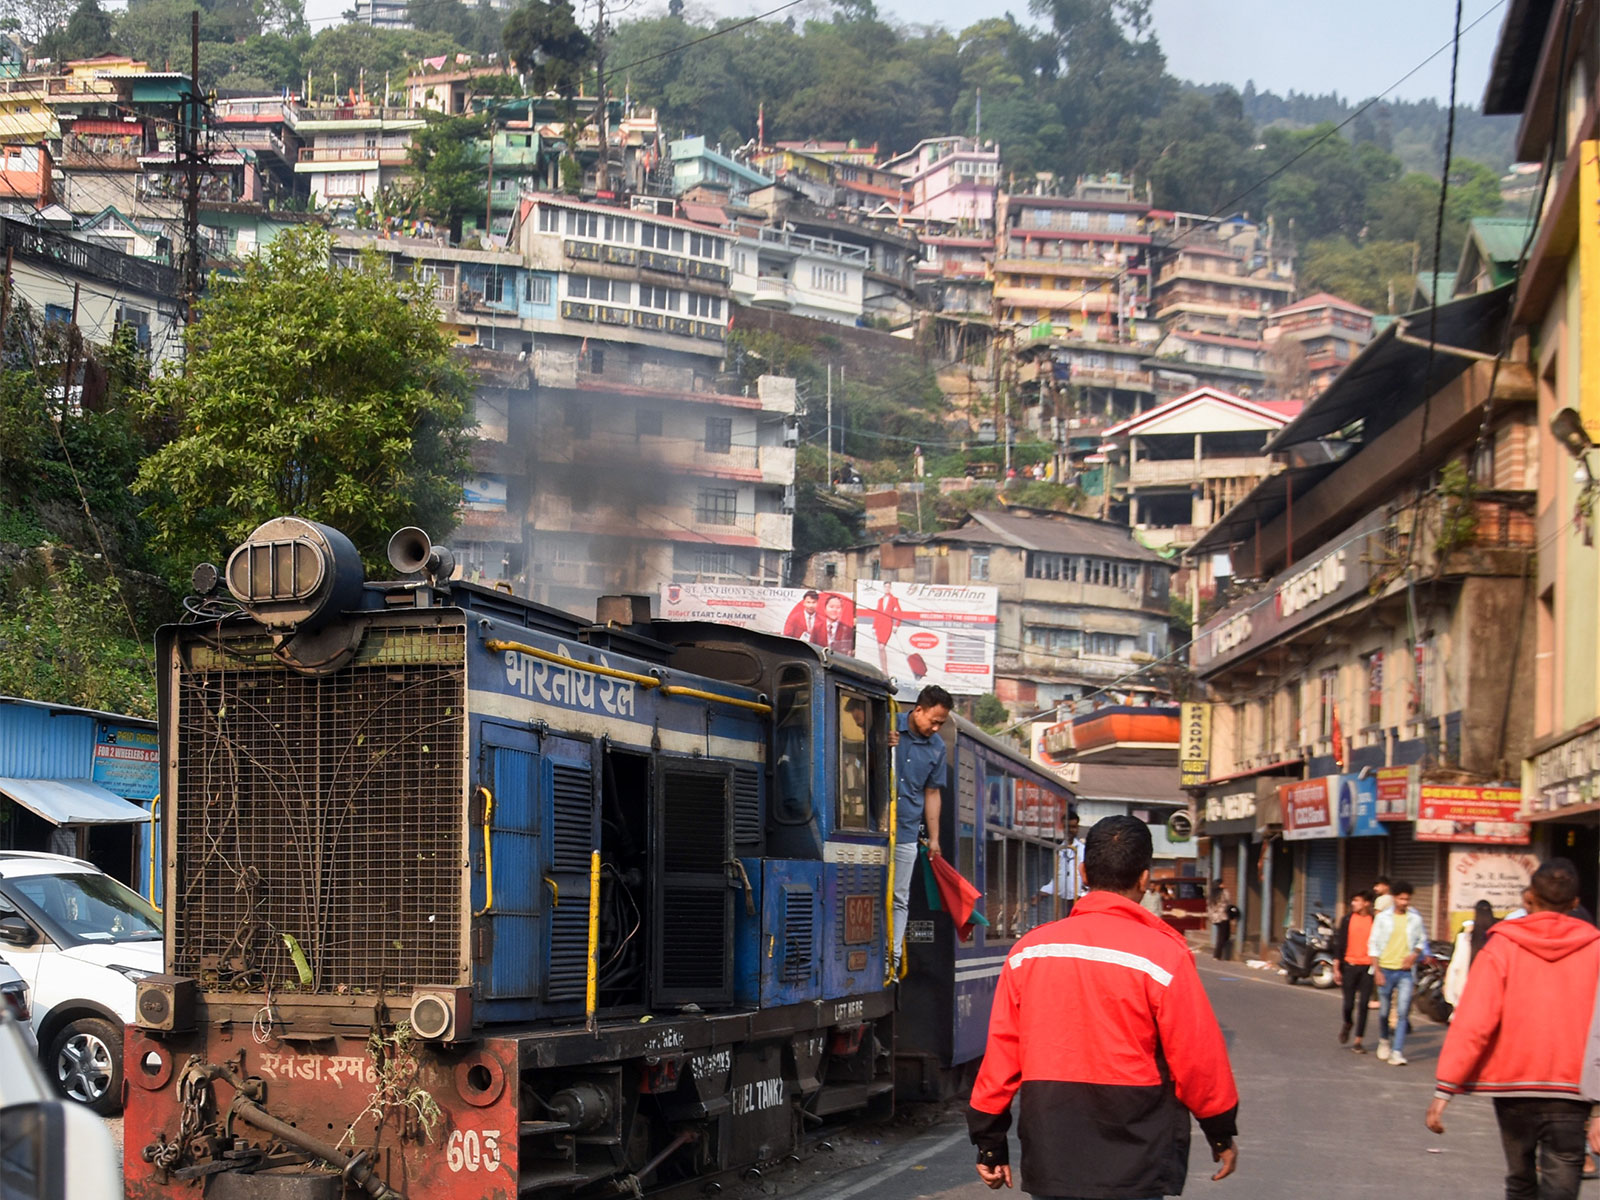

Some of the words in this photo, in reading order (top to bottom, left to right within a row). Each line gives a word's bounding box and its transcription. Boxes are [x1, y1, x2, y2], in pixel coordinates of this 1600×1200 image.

[1189, 706, 1203, 758] PRADHAN
[98, 745, 110, 757] FOR
[115, 747, 145, 760] WHEELERS
[1421, 787, 1478, 800] DENTAL
[849, 898, 871, 925] 603
[834, 1002, 847, 1021] LIFT
[732, 1082, 755, 1116] FUEL
